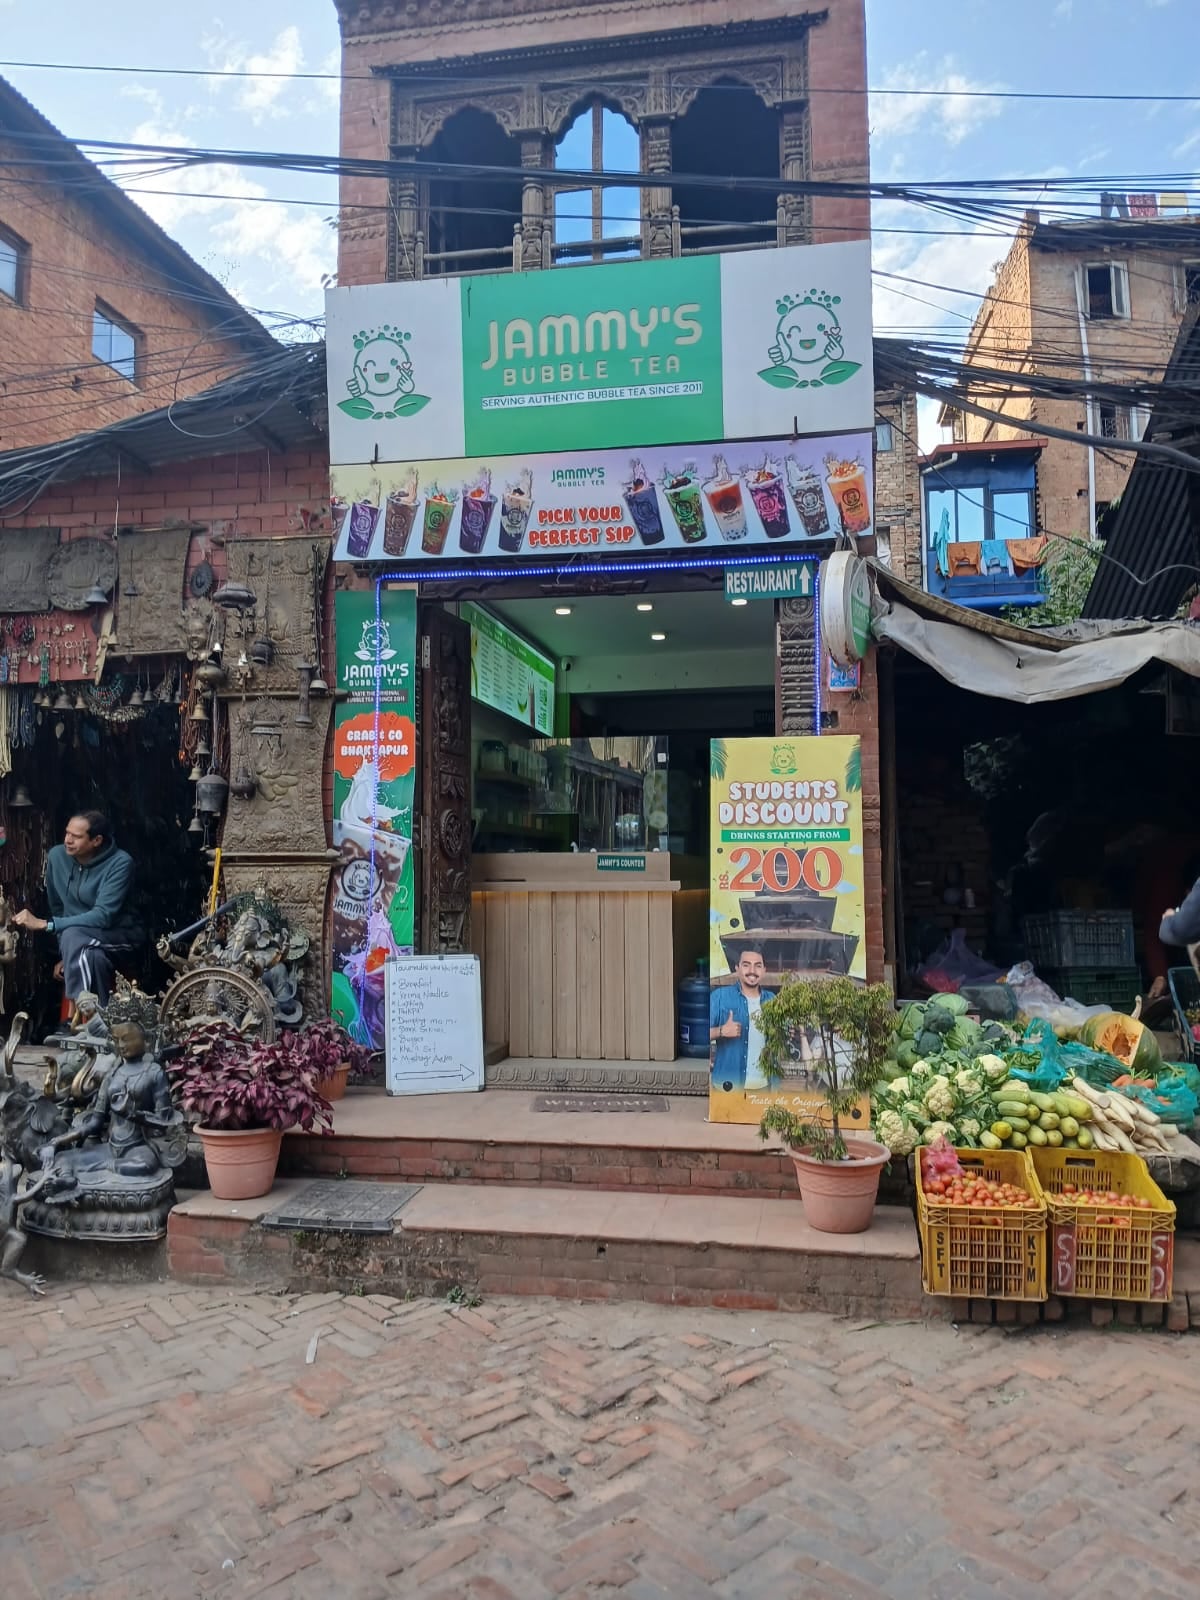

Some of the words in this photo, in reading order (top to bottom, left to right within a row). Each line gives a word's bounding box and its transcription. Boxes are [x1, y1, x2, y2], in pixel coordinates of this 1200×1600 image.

[481, 303, 703, 370] JAMMY'S
[503, 360, 609, 386] BUBBLE
[630, 354, 681, 376] TEA
[482, 396, 526, 408] SERVING
[528, 392, 585, 405] AUTHENTIC
[587, 388, 625, 400] BUBBLE
[627, 387, 647, 397] TEA
[648, 385, 681, 396] SINCE
[682, 382, 703, 394] 2011
[551, 467, 605, 482] JAMMY'S
[538, 508, 574, 524] PICK
[578, 506, 622, 522] YOUR
[528, 527, 601, 547] PERFECT
[605, 525, 635, 543] SIP
[726, 568, 798, 594] RESTAURANT
[342, 663, 410, 681] JAMMY'S
[387, 678, 403, 686] TEA
[346, 730, 376, 741] GRAB
[387, 729, 403, 741] GO
[341, 744, 409, 756] BHAKTAPUR
[729, 780, 837, 801] STUDENTS
[719, 801, 849, 825] DISCOUNT
[730, 832, 765, 840] DRINKS
[767, 831, 812, 839] STARTING
[813, 831, 841, 839] FROM
[620, 859, 645, 868] COUNTER
[729, 846, 844, 892] 200
[748, 1095, 772, 1105] Taste
[776, 1095, 788, 1105] the
